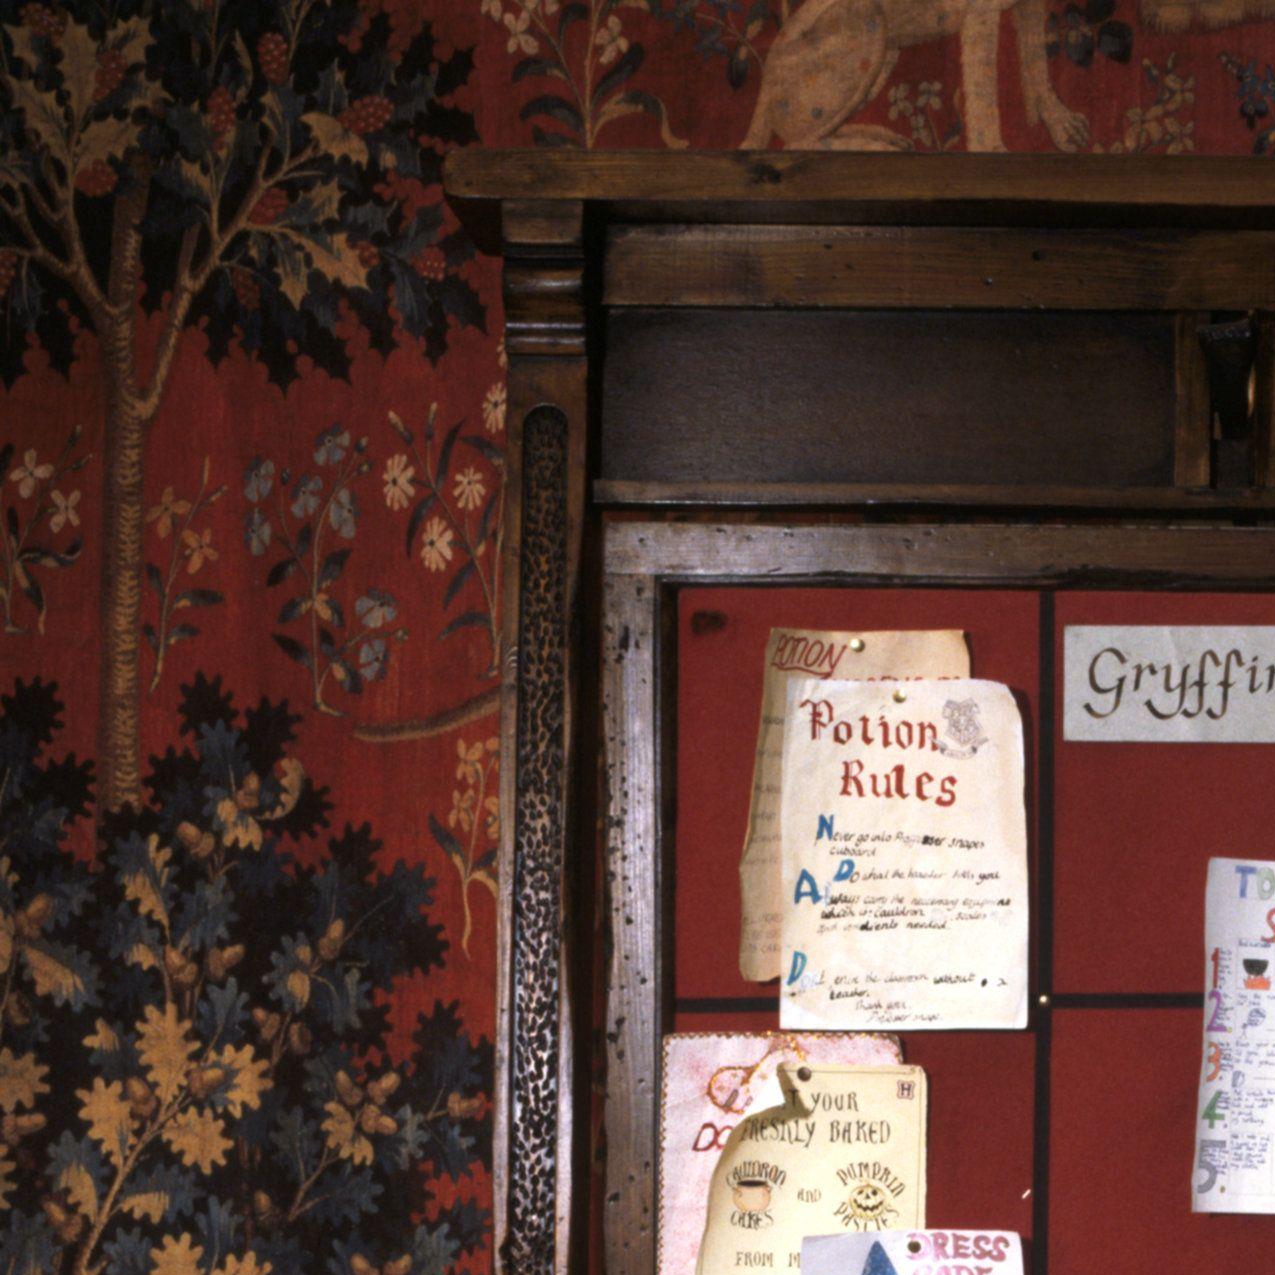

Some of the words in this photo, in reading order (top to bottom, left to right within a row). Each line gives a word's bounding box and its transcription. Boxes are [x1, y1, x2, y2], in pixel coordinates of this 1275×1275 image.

[800, 699, 939, 751] Potion
[839, 759, 958, 807] Rules
[978, 870, 1001, 885] you
[811, 1091, 859, 1113] YOUR
[830, 1119, 891, 1143] BAKED
[906, 1231, 1011, 1262] DRESS
[736, 1253, 774, 1267] FROM
